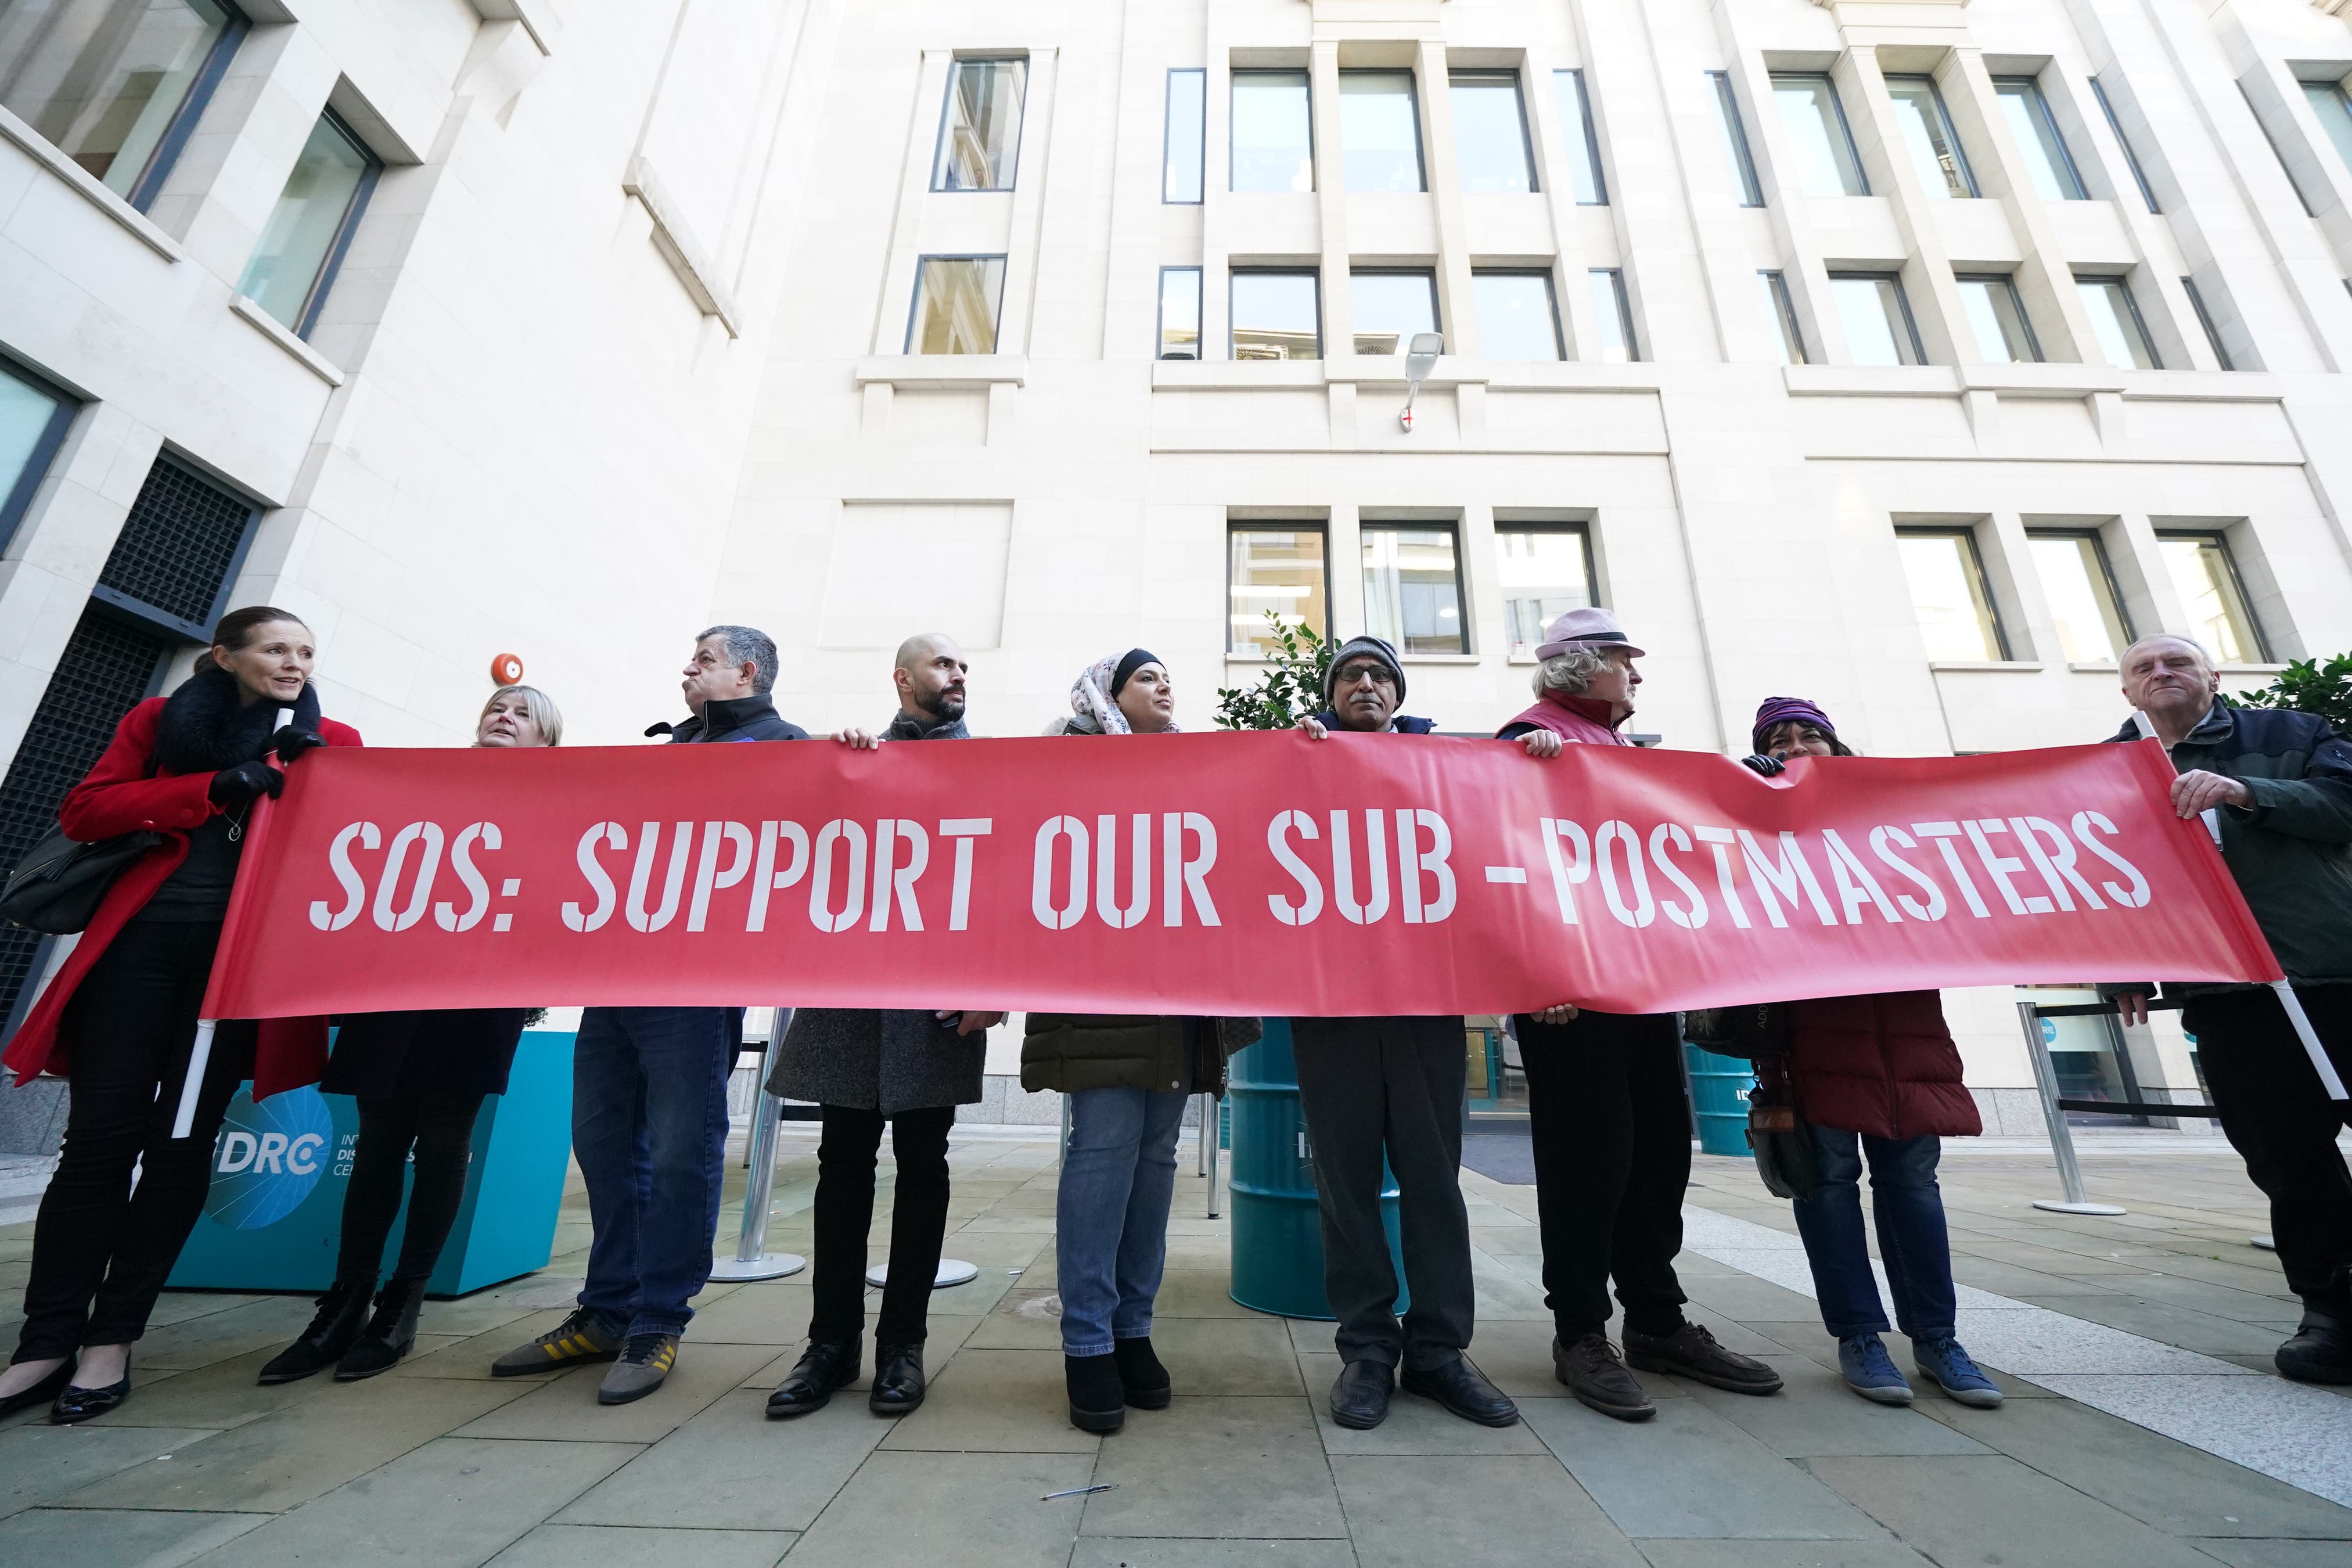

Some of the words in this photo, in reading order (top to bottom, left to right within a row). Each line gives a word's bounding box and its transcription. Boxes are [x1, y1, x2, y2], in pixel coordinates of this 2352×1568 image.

[309, 821, 521, 932] SOS:
[561, 818, 992, 933] SUPPORT
[1032, 812, 1222, 930] OUR
